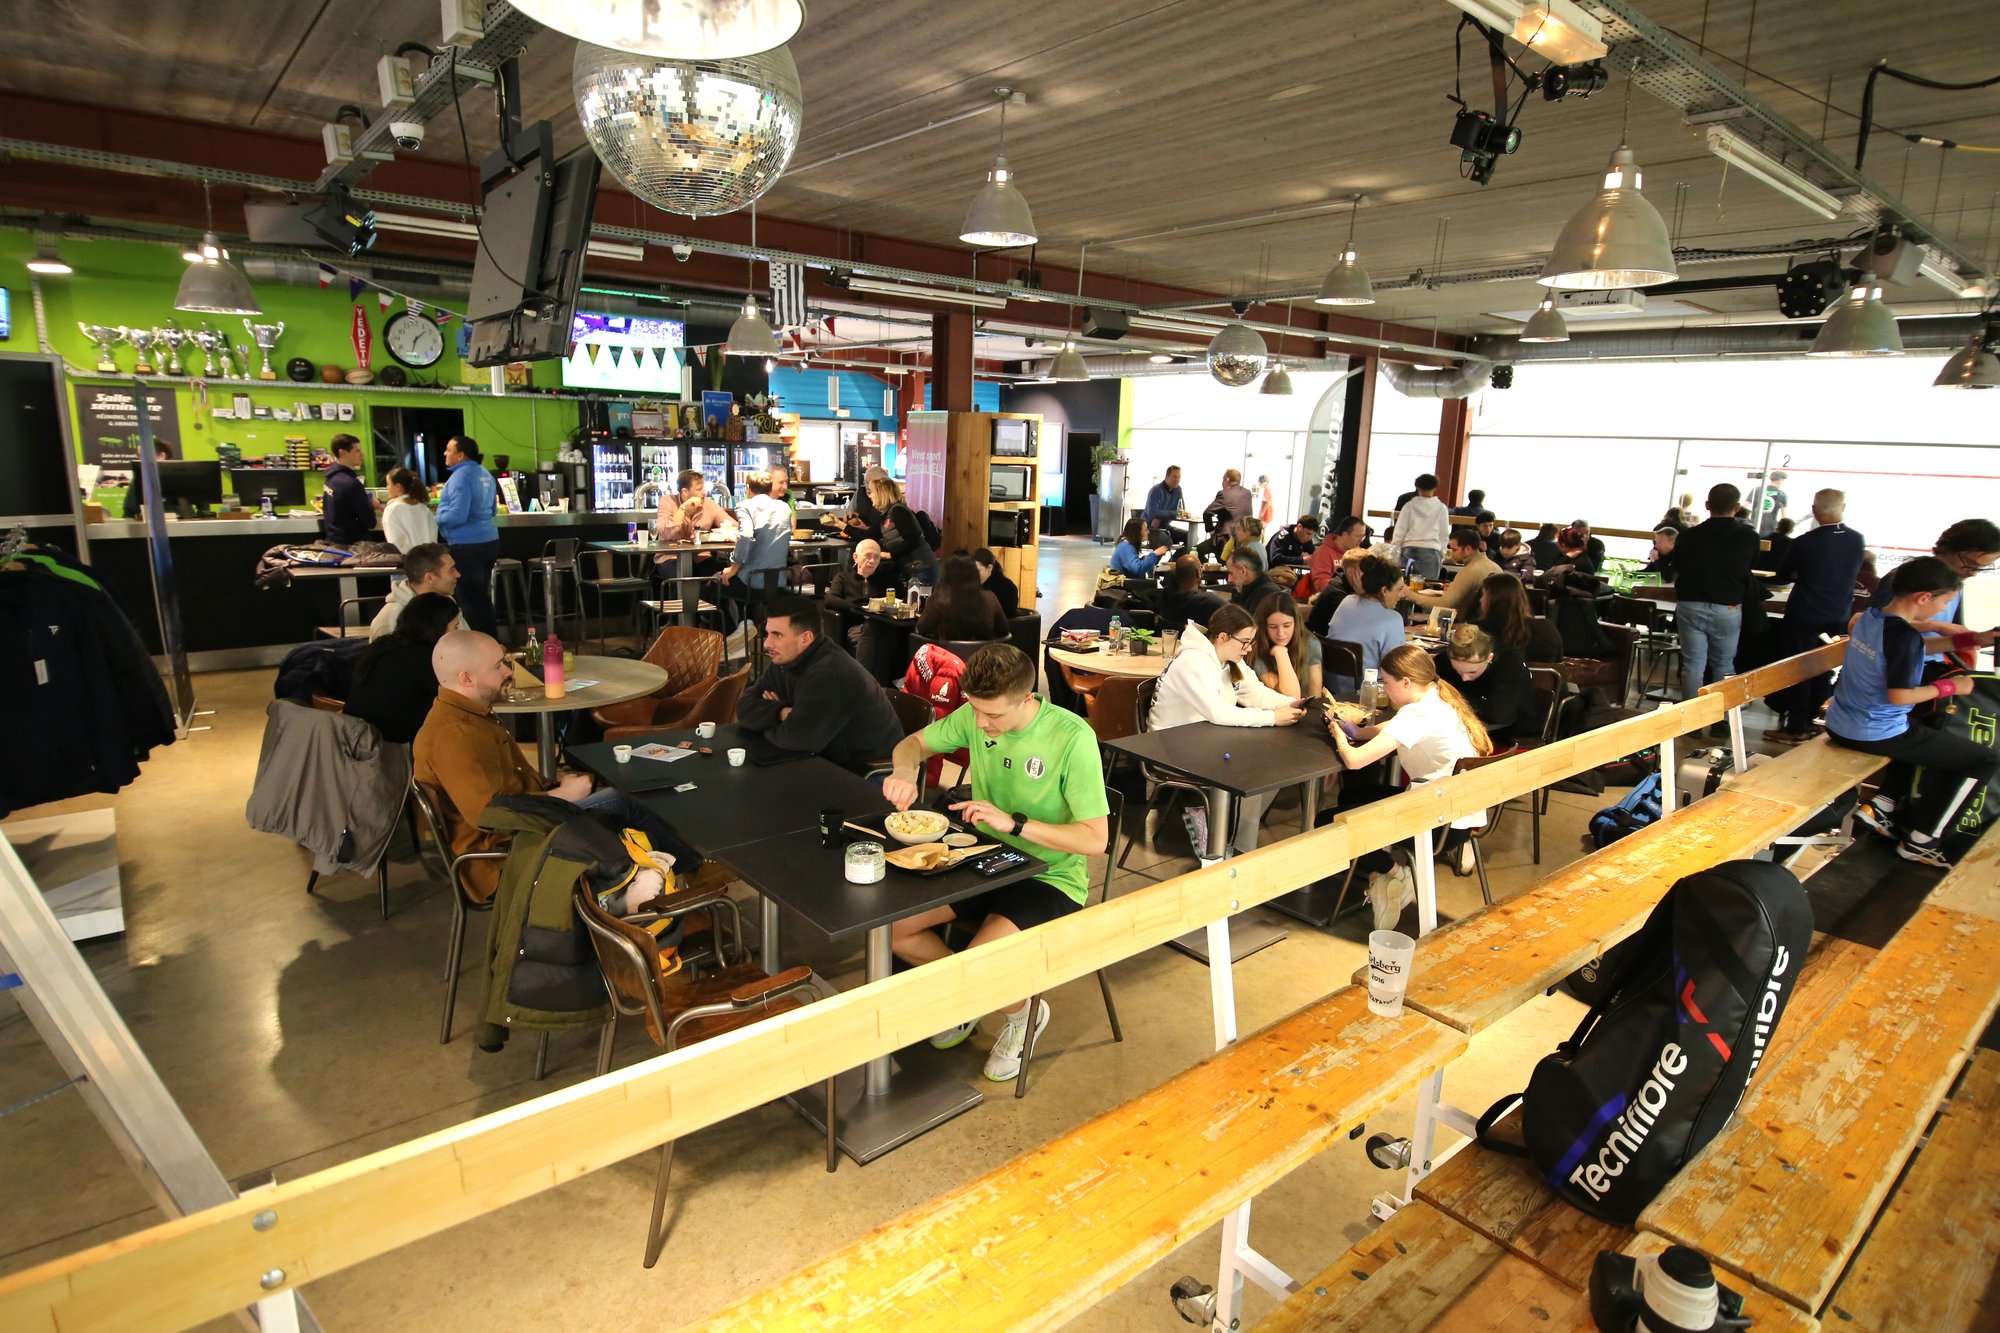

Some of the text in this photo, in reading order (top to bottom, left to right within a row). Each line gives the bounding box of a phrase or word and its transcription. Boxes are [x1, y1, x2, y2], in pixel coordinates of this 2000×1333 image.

[357, 308, 366, 367] VEDETT
[95, 393, 133, 403] Salle
[1319, 400, 1343, 518] DUNLOP
[1782, 454, 1791, 468] 2
[1569, 1042, 1688, 1201] Tecnifibre
